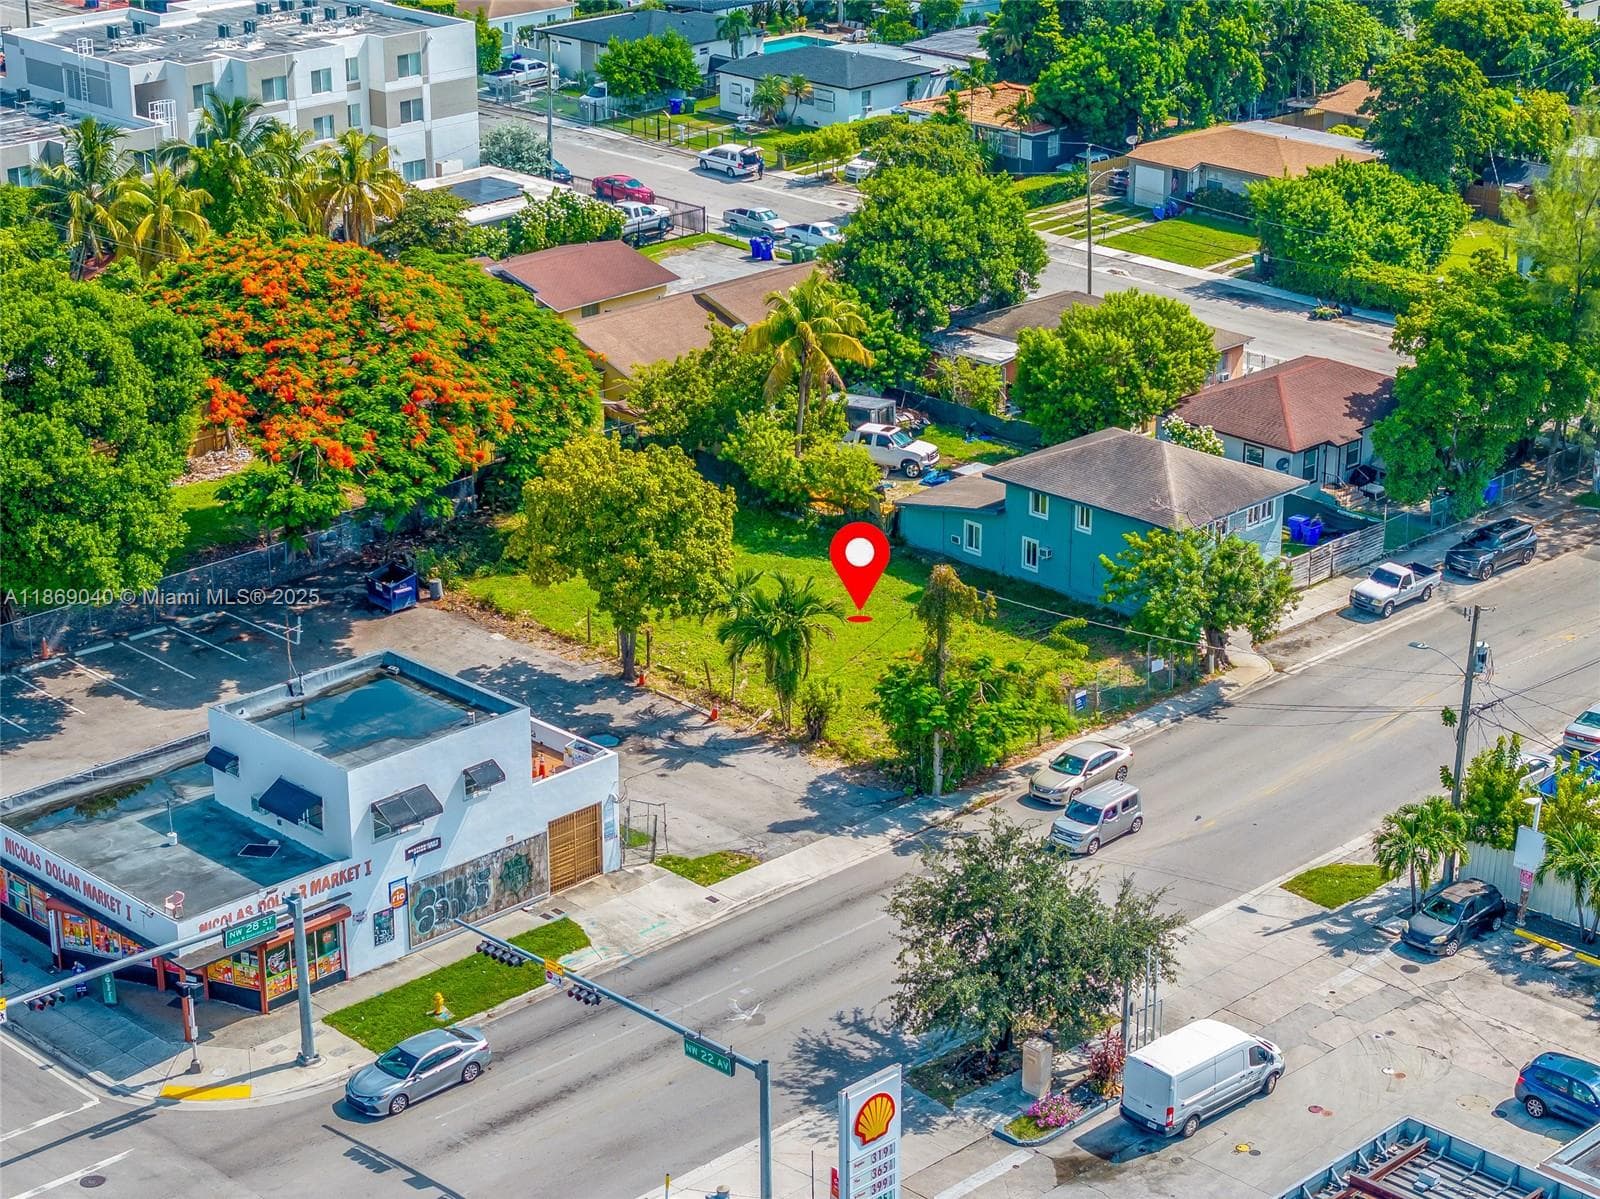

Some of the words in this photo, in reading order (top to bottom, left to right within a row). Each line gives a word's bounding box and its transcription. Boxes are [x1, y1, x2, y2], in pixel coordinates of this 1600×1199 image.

[5, 837, 41, 871] NICOLAS
[45, 859, 81, 893] DOLLAR
[83, 881, 121, 915] MARKET
[310, 864, 361, 896] MARKET
[230, 928, 242, 939] NW
[245, 921, 259, 934] 28
[262, 916, 273, 926] ST
[685, 1043, 698, 1056] NW
[700, 1050, 714, 1065] 22
[717, 1058, 729, 1071] AV
